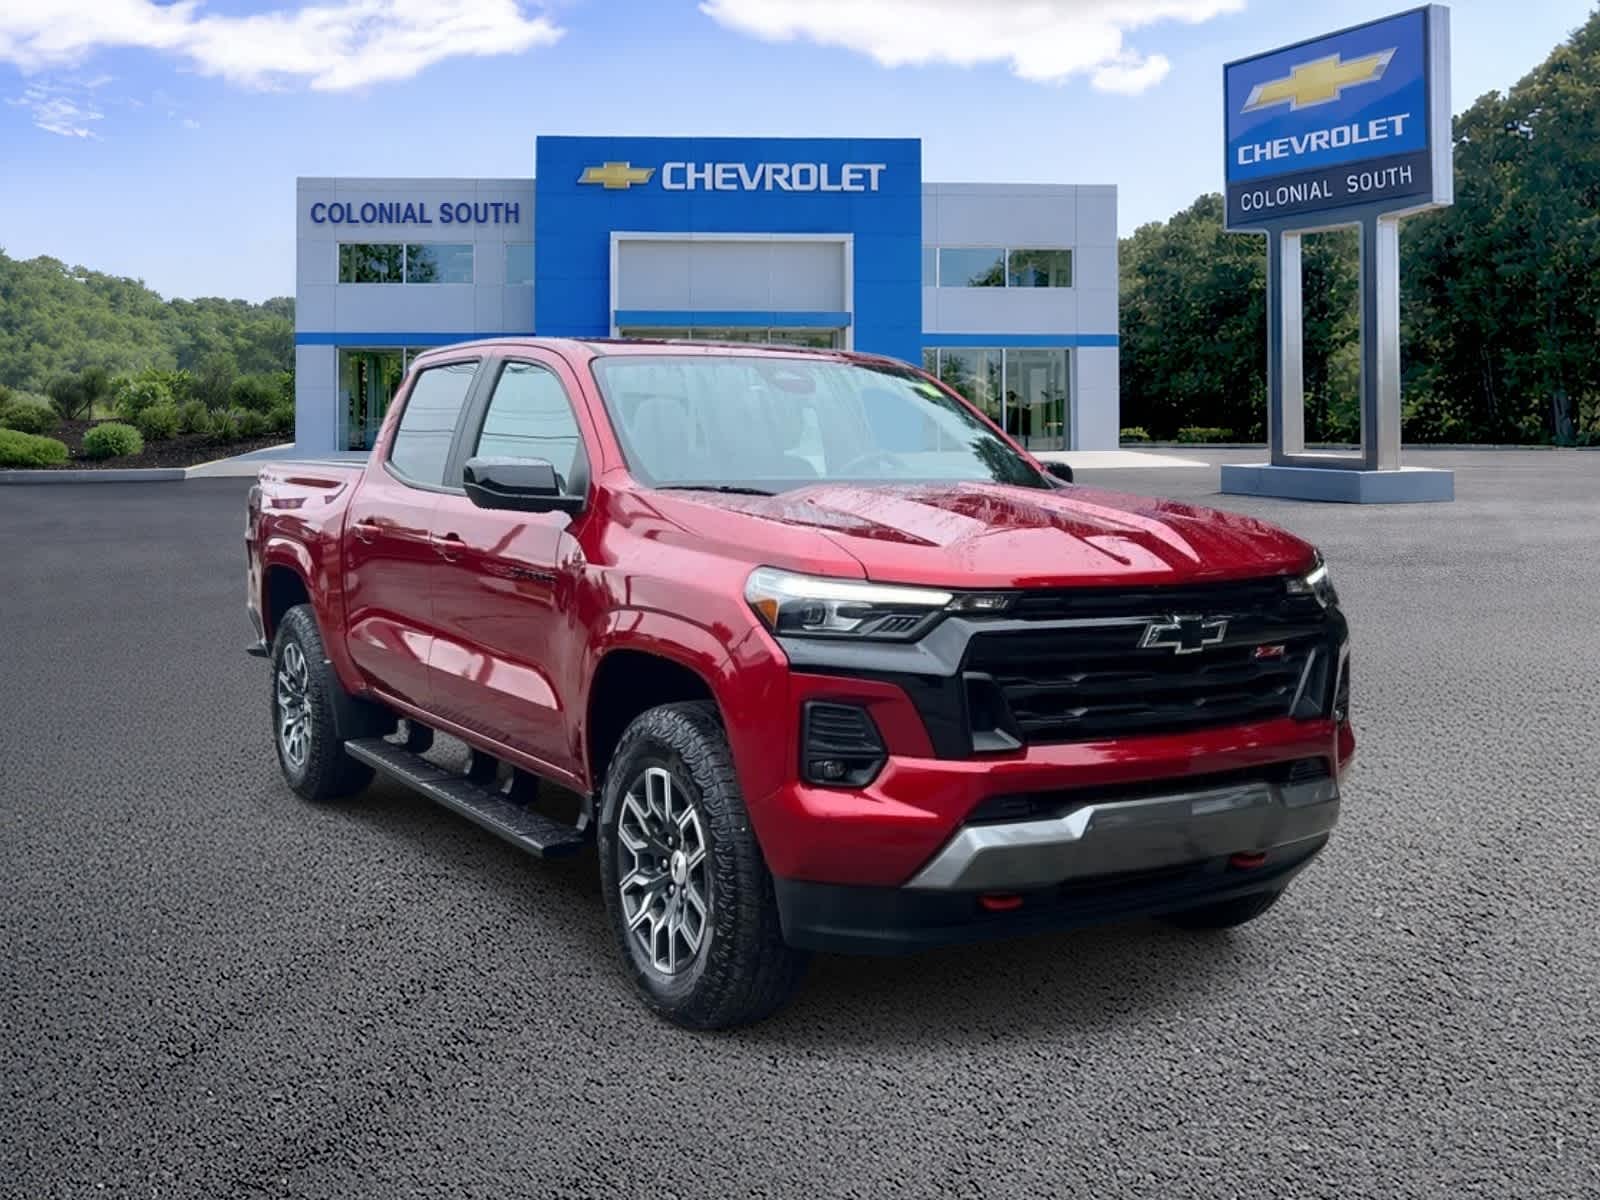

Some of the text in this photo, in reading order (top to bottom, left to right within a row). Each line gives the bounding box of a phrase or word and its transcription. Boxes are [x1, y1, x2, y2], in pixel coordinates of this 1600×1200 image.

[1237, 113, 1410, 165] CHEVROLET
[662, 162, 886, 192] CHEVROLET
[1240, 165, 1412, 211] COLONIAL SOUTH
[311, 202, 520, 224] COLONIAL SOUTH
